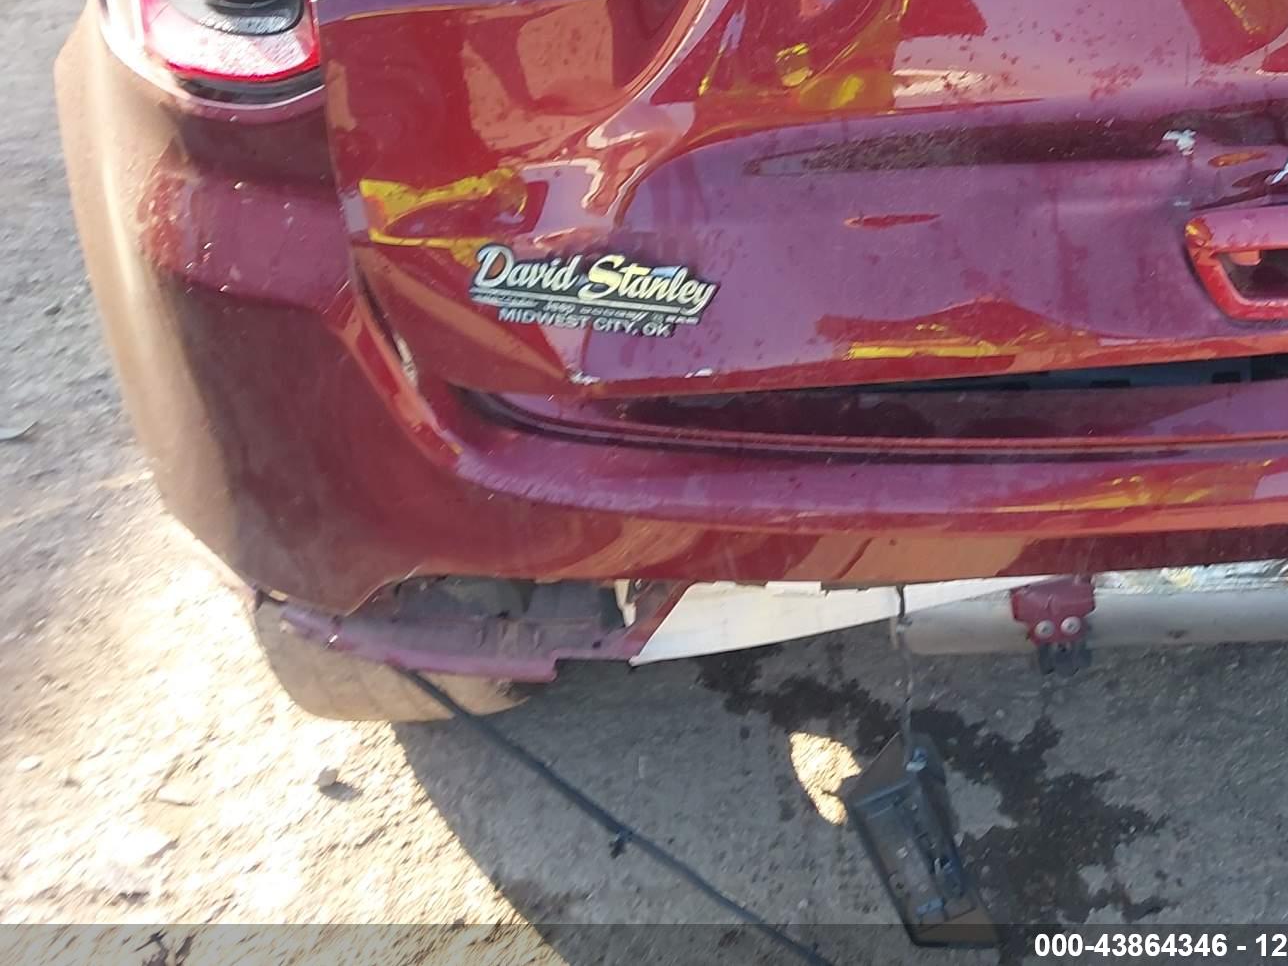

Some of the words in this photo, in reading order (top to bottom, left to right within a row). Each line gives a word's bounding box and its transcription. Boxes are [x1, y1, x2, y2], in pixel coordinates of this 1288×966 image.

[472, 244, 585, 292] David
[577, 253, 718, 316] Stanley
[497, 306, 592, 331] MIDWEST
